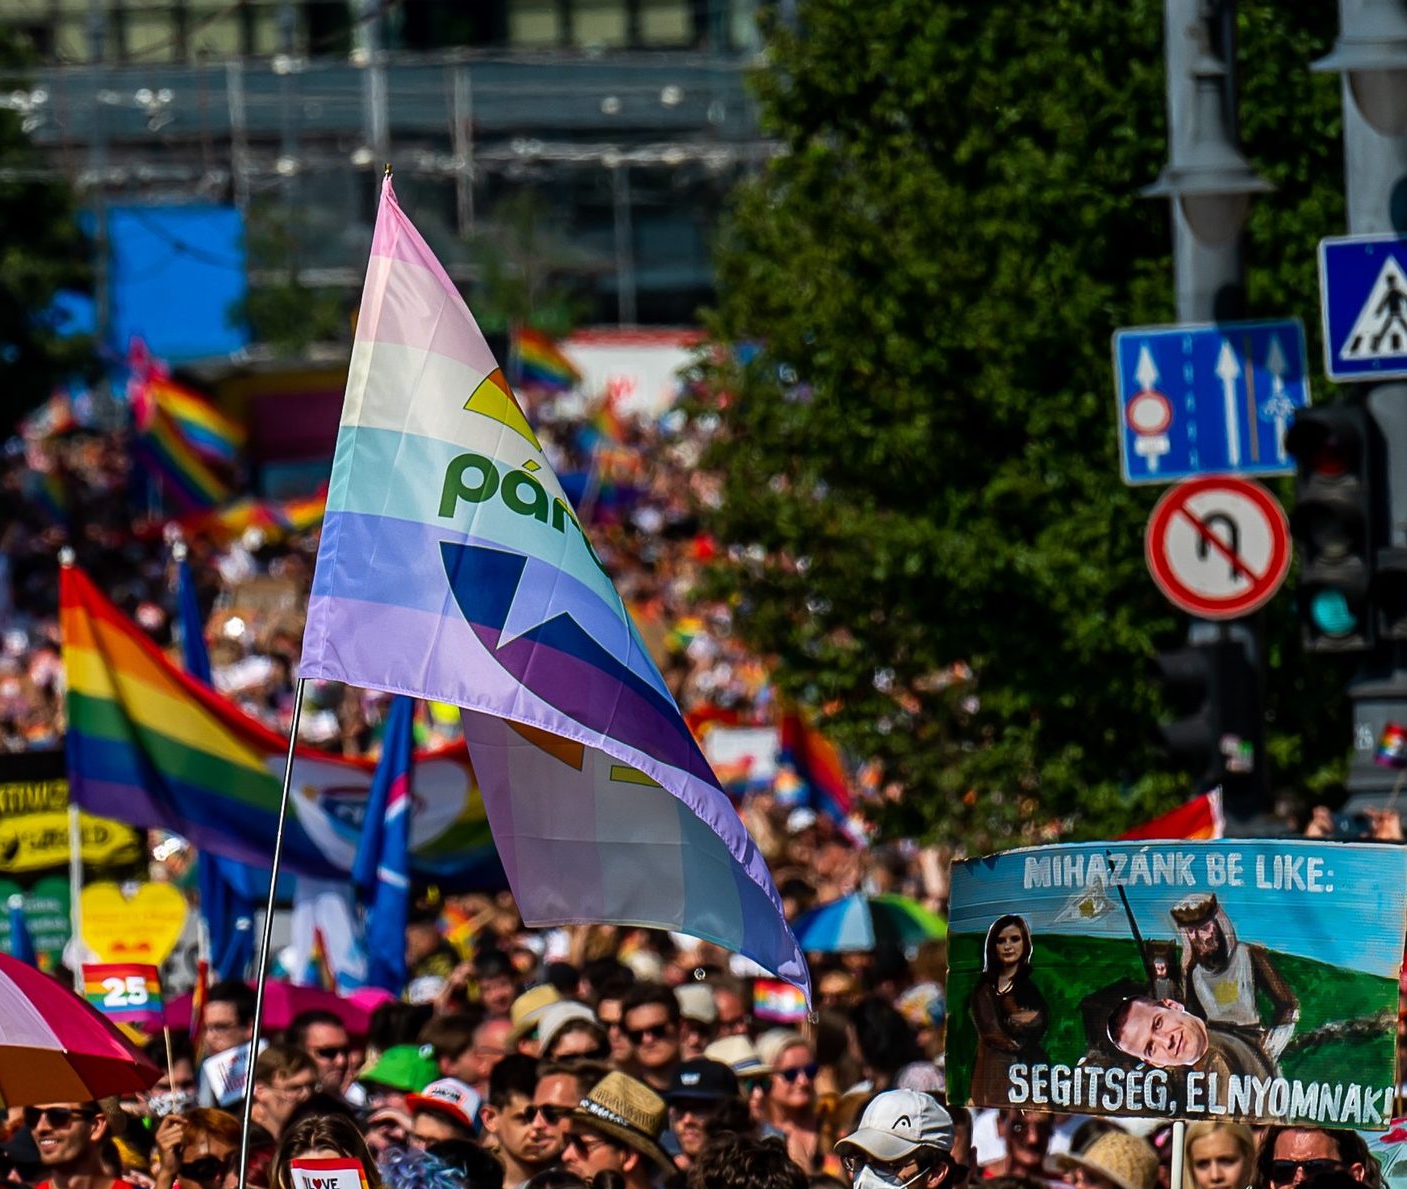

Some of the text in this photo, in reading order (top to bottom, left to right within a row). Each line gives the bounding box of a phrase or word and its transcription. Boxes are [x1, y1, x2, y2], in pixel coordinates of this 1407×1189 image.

[1023, 847, 1335, 893] MIHAZÁNK BE LIKE:
[101, 975, 148, 1007] 25
[1007, 1056, 1394, 1126] SEGÍTSÉG, ELNYOMNAK!
